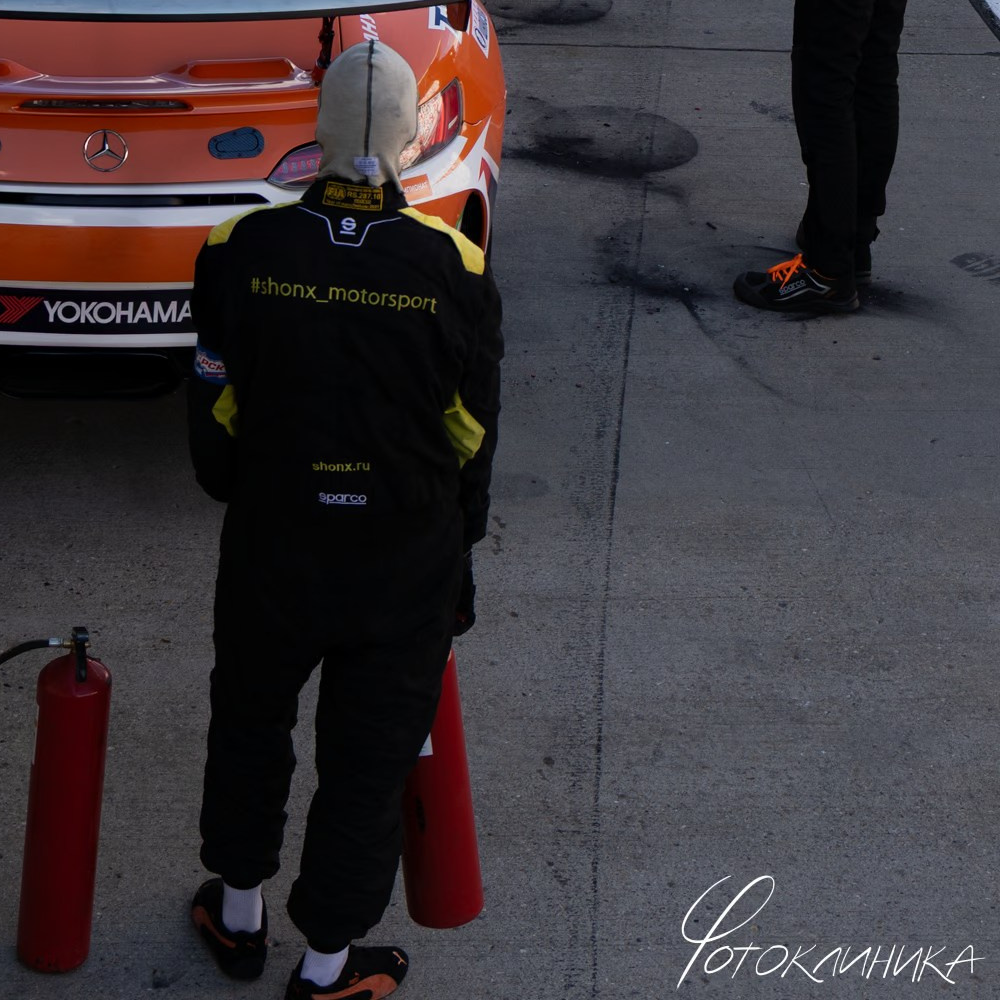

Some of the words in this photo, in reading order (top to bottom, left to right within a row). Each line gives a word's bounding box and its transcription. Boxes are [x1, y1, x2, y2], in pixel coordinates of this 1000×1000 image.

[250, 277, 438, 314] #shonx_motorsport
[43, 299, 193, 324] YOKOHAMA
[312, 460, 371, 473] shonx.ru
[318, 491, 368, 506] sparco
